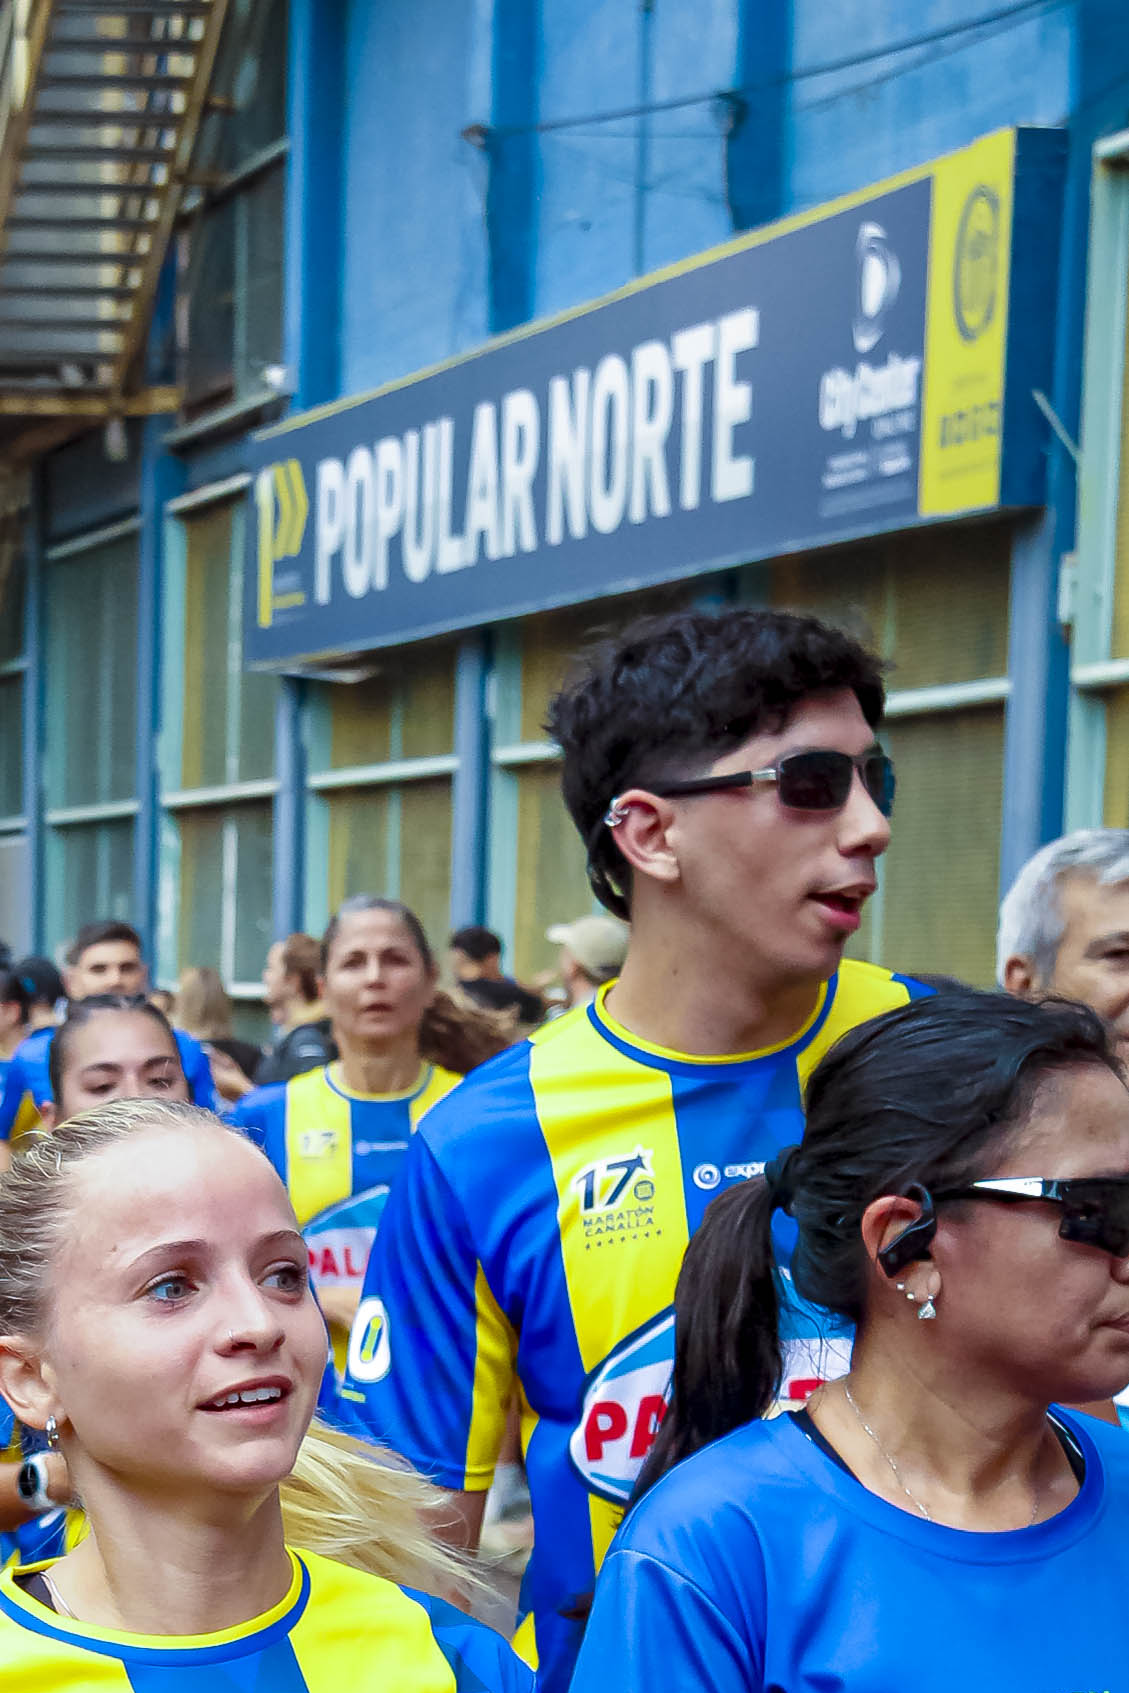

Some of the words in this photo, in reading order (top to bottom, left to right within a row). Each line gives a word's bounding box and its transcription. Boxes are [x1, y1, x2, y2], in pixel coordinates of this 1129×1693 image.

[315, 388, 538, 606] POPULAR
[545, 306, 760, 547] NORTE
[576, 1156, 647, 1211] 17
[585, 1217, 654, 1237] CANALLA
